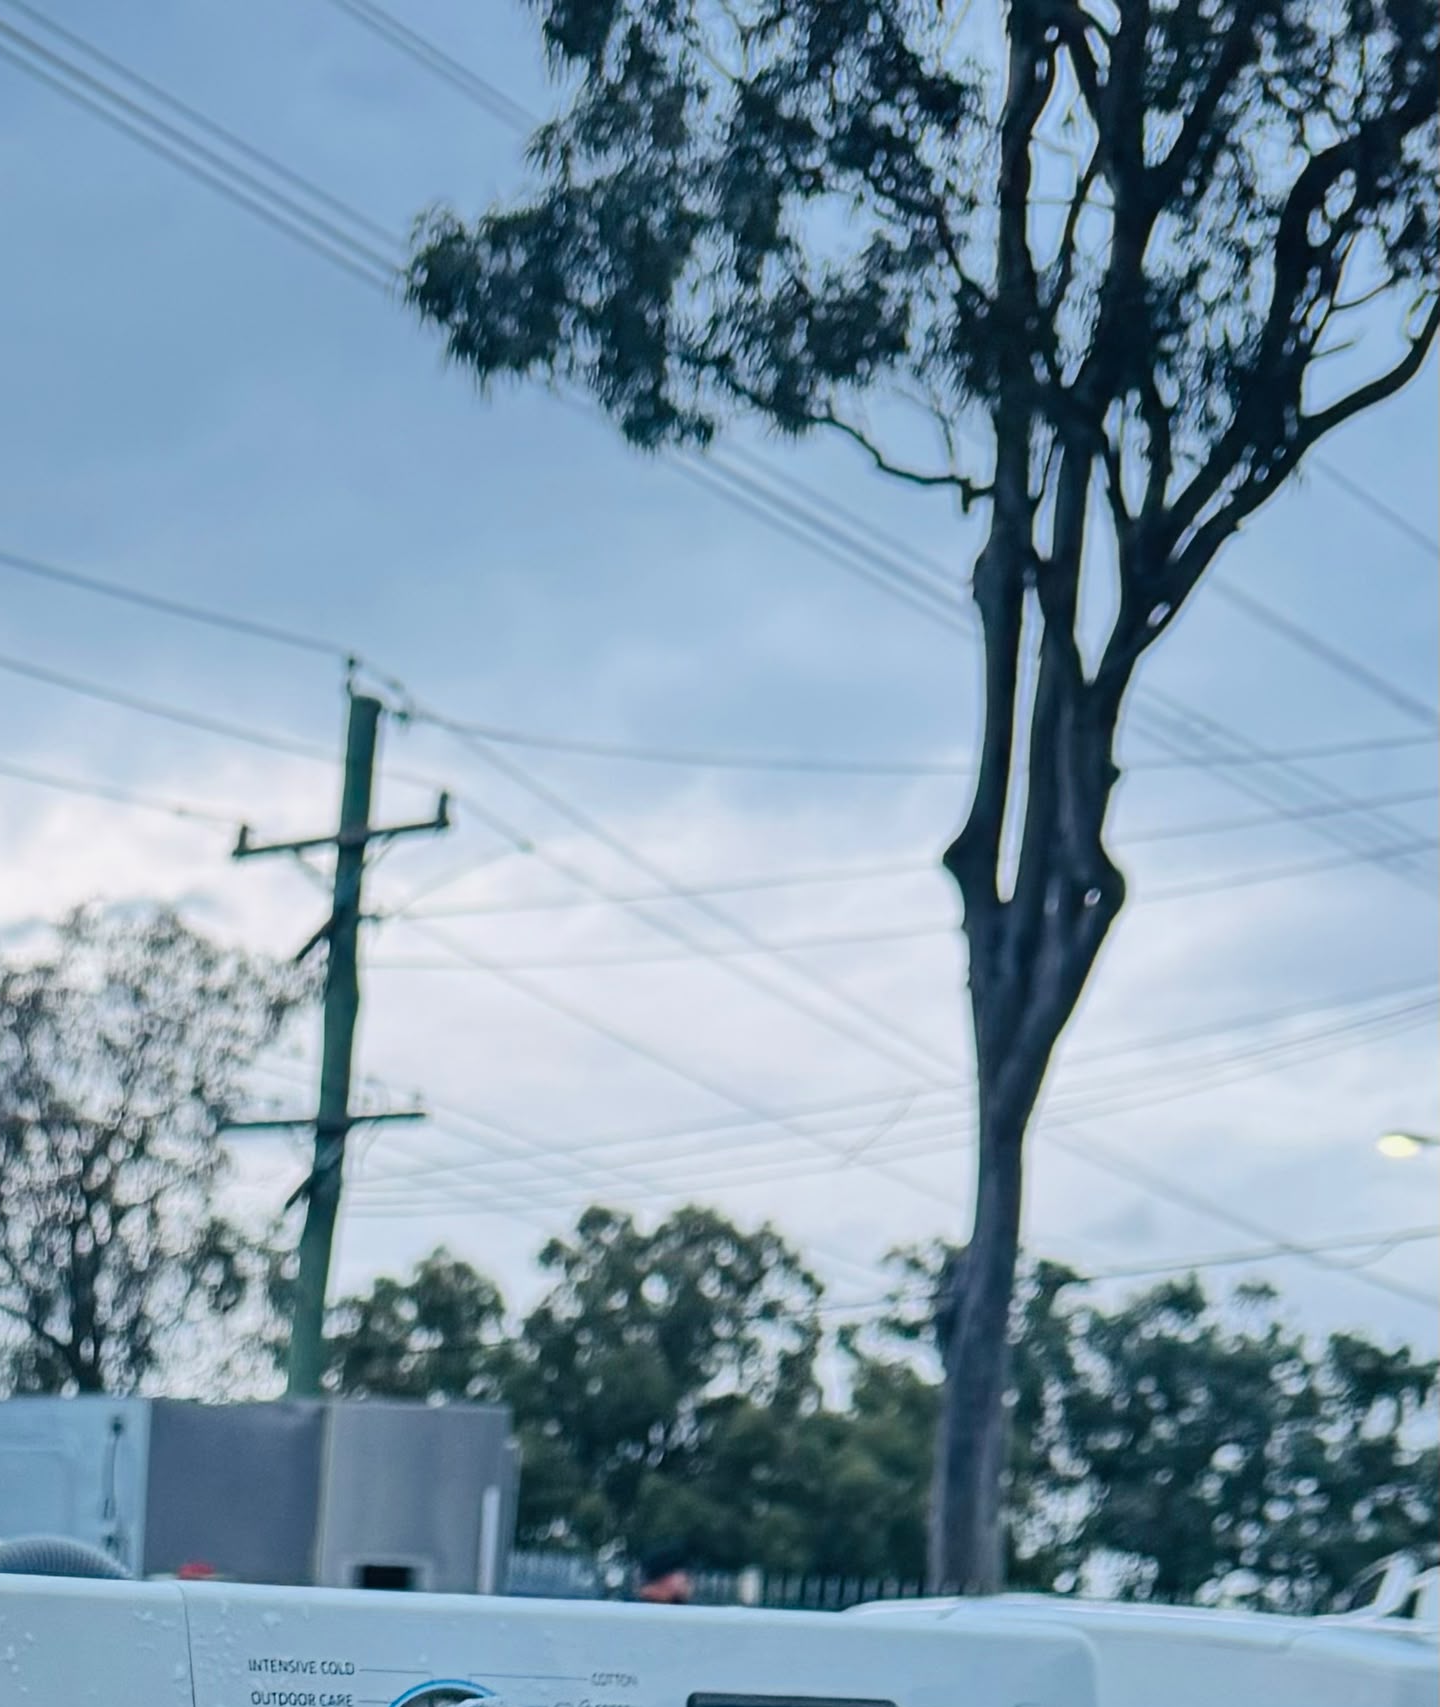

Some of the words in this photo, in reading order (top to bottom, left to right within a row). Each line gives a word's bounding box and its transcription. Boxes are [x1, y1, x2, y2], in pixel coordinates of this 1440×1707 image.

[248, 1658, 317, 1674] INTENSIVE
[321, 1661, 355, 1675] COLD
[591, 1673, 639, 1687] COTTON
[251, 1690, 316, 1706] OUTDOOR
[320, 1693, 354, 1707] CARE
